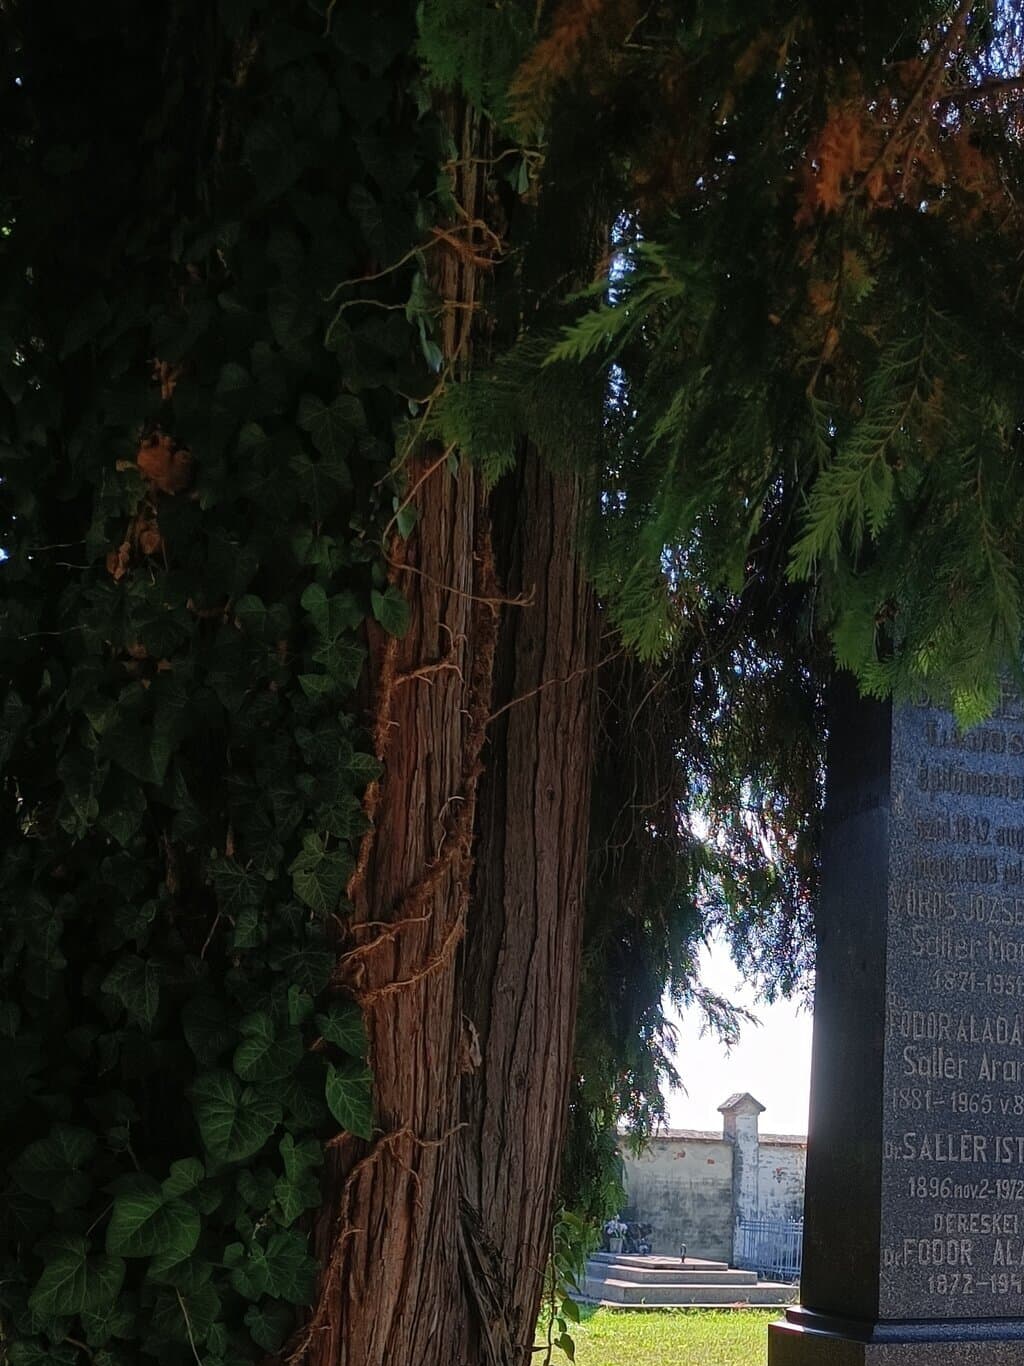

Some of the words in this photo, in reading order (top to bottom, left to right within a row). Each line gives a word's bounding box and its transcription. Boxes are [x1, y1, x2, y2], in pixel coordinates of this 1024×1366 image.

[889, 1008, 952, 1042] FODOR
[933, 1213, 1019, 1235] DERESKEI
[903, 1238, 974, 1267] FODOR
